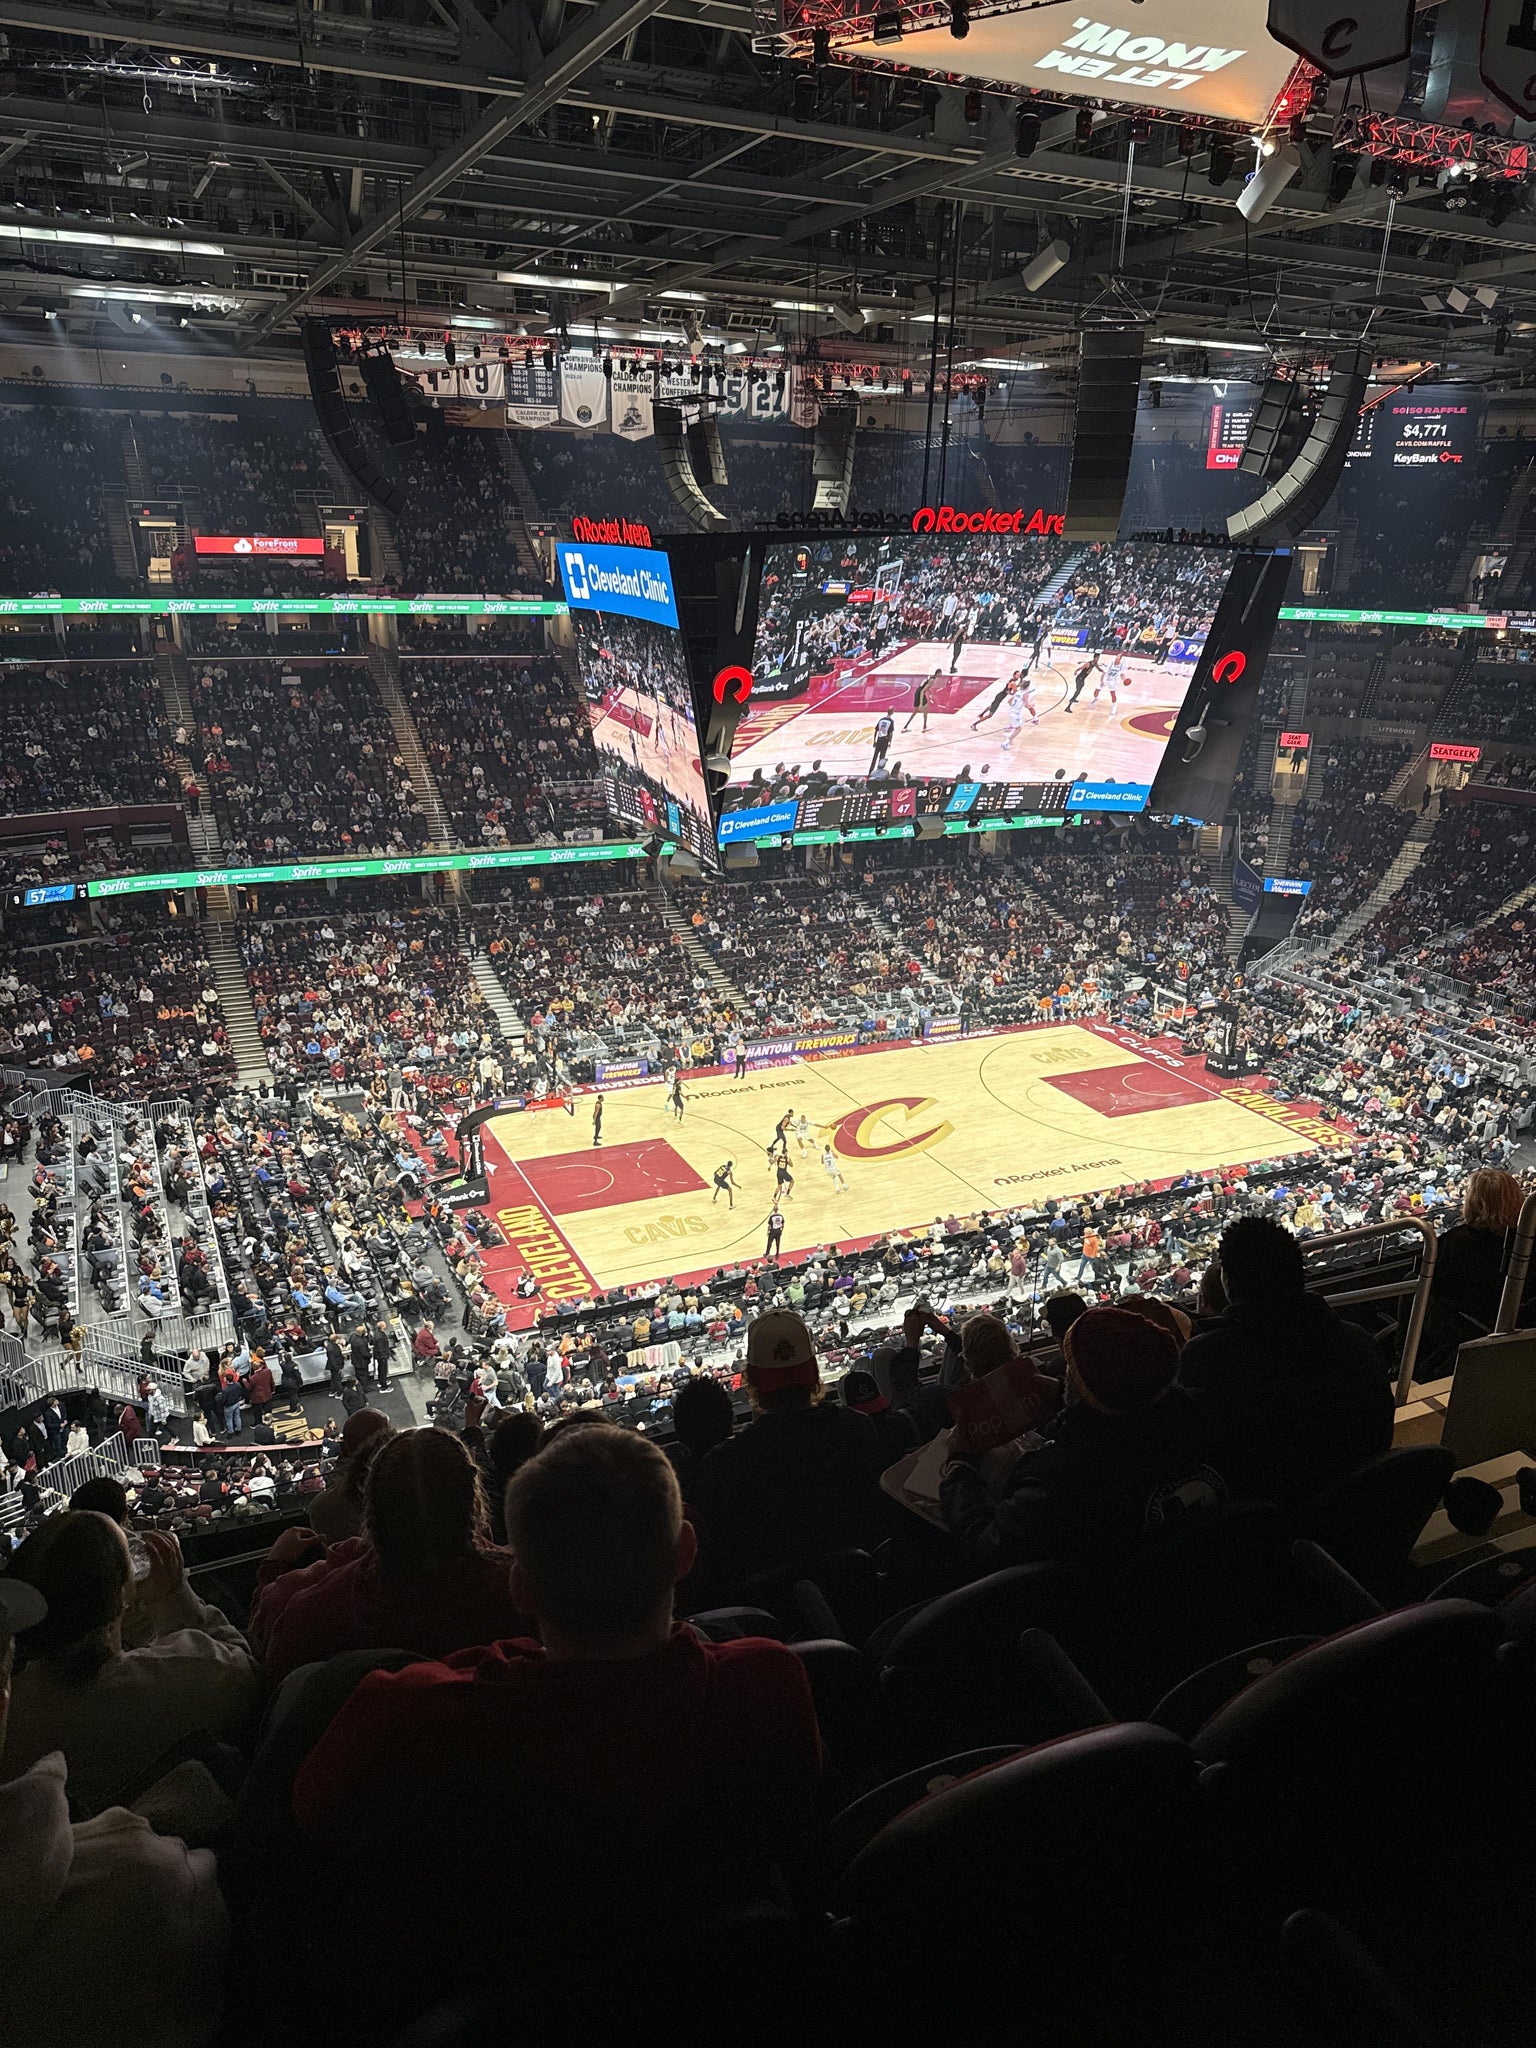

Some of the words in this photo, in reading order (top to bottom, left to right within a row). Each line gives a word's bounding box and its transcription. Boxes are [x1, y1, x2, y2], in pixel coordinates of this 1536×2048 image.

[1061, 17, 1248, 72] KNOW.
[1033, 50, 1118, 78] EM
[1103, 66, 1204, 90] LET
[564, 362, 603, 374] CHAMPIONS
[475, 365, 489, 394] 9
[638, 373, 653, 383] CUP
[667, 377, 693, 387] WESTER
[613, 382, 652, 394] CHAMPIONS
[756, 382, 784, 412] 27
[1424, 406, 1467, 414] RAFFLE
[1403, 423, 1447, 438] $4,771
[1393, 453, 1438, 464] KeyBank
[936, 507, 1024, 534] Rocket
[1024, 508, 1065, 535] Are
[584, 517, 623, 544] Rocket
[622, 518, 652, 548] Arena
[253, 538, 298, 548] ForeFront
[587, 563, 641, 597] Cleveland
[639, 570, 670, 604] Clinic
[0, 601, 18, 611] rite
[78, 600, 109, 612] Sprite
[167, 601, 196, 613] Sprite
[252, 601, 279, 612] Sprite
[332, 601, 359, 613] Sprite
[408, 602, 434, 613] Sprite
[483, 602, 507, 613] Sprite
[554, 603, 569, 614] Spri
[1293, 609, 1317, 619] Sprite
[1359, 612, 1383, 622] Sprite
[1425, 614, 1450, 625] Sprite
[1510, 618, 1536, 627] oswald
[1051, 627, 1078, 637] HANTOM
[1051, 636, 1079, 645] EWORKS
[805, 726, 876, 746] CAV
[1378, 726, 1416, 735] LITEHOUSE
[1433, 746, 1477, 759] SEATGEEK
[945, 786, 951, 795] 9
[1086, 791, 1121, 800] Cleveland
[1122, 793, 1143, 801] Clinic
[897, 803, 910, 814] 47
[924, 804, 939, 813] 18.9
[953, 800, 965, 810] 57
[734, 815, 770, 830] Cleveland
[770, 812, 792, 824] Clinic
[468, 855, 496, 867] Sprite
[549, 849, 576, 862] Sprite
[291, 866, 322, 879] Sprite
[382, 860, 412, 873] Sprite
[196, 872, 228, 885] Sprite
[1273, 879, 1303, 888] SHERWIN
[98, 880, 130, 894] Sprite
[30, 890, 46, 903] 57
[80, 889, 87, 898] 5
[13, 895, 20, 905] 9
[746, 1043, 793, 1058] HANTOM
[795, 1034, 857, 1051] FIREWORKS
[1118, 1036, 1185, 1068] CLIFFS
[1031, 1047, 1092, 1064] CAVS
[605, 1062, 639, 1072] PHANTOM
[602, 1068, 642, 1079] FIREWORKS
[589, 1075, 665, 1093] TRUSTEDS
[699, 1085, 758, 1100] Rocket
[759, 1077, 806, 1091] Arena
[1220, 1087, 1351, 1146] CAVALIERS
[1008, 1166, 1071, 1184] Rocket
[1070, 1158, 1123, 1173] Arena
[623, 1215, 709, 1245] CAVS
[496, 1204, 593, 1300] CLEVELAND
